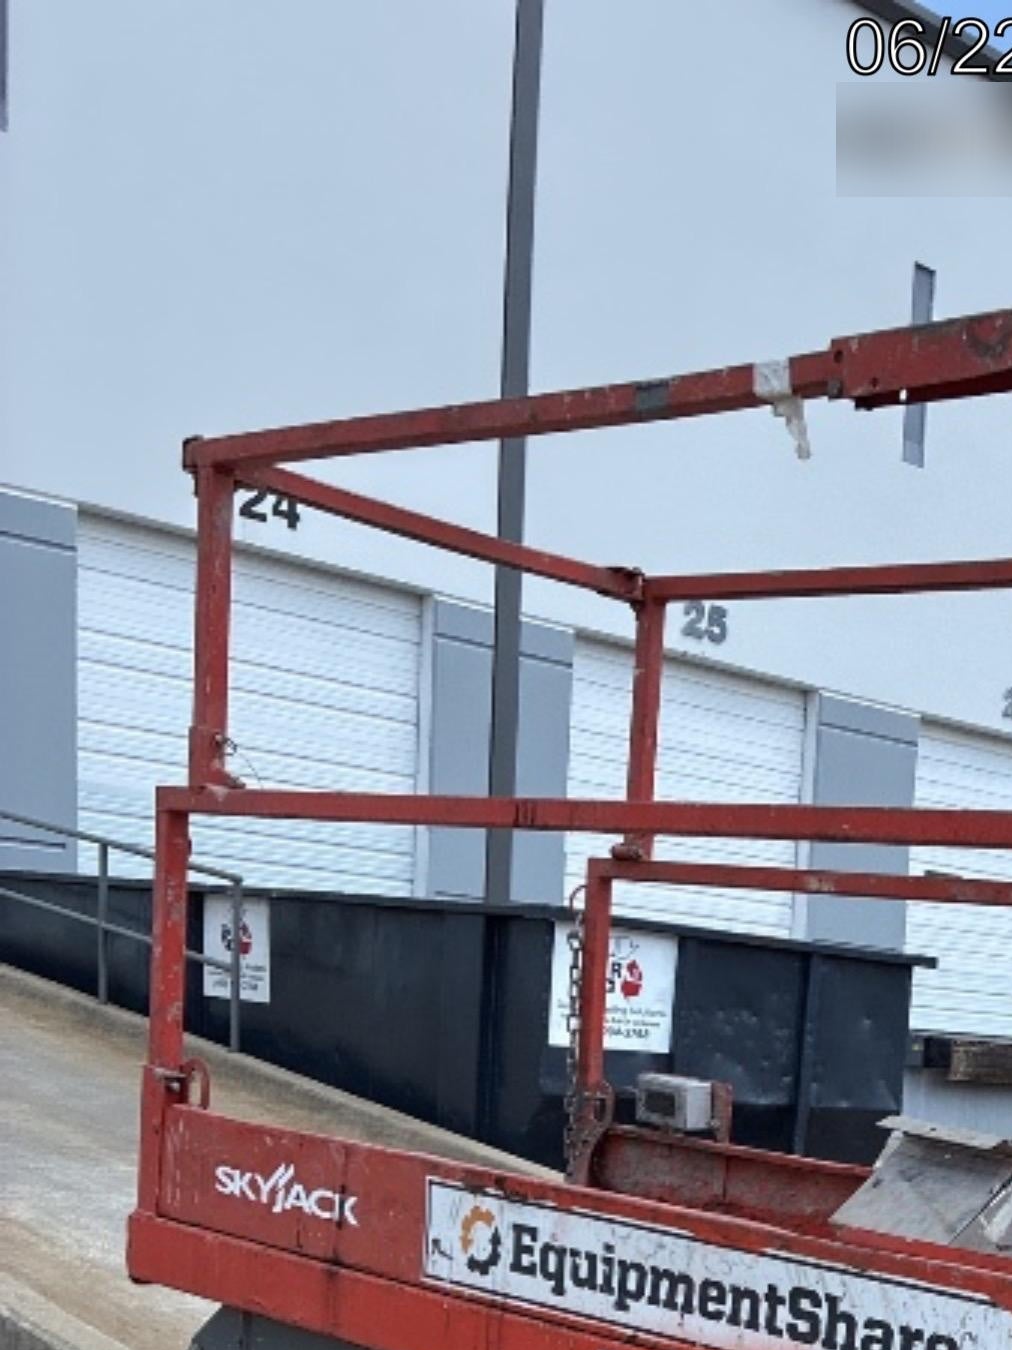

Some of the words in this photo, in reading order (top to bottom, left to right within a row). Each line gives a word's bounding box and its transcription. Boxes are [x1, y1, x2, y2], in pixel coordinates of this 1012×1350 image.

[239, 489, 301, 531] 24
[681, 600, 728, 645] 25
[214, 1161, 358, 1227] SKYJACK
